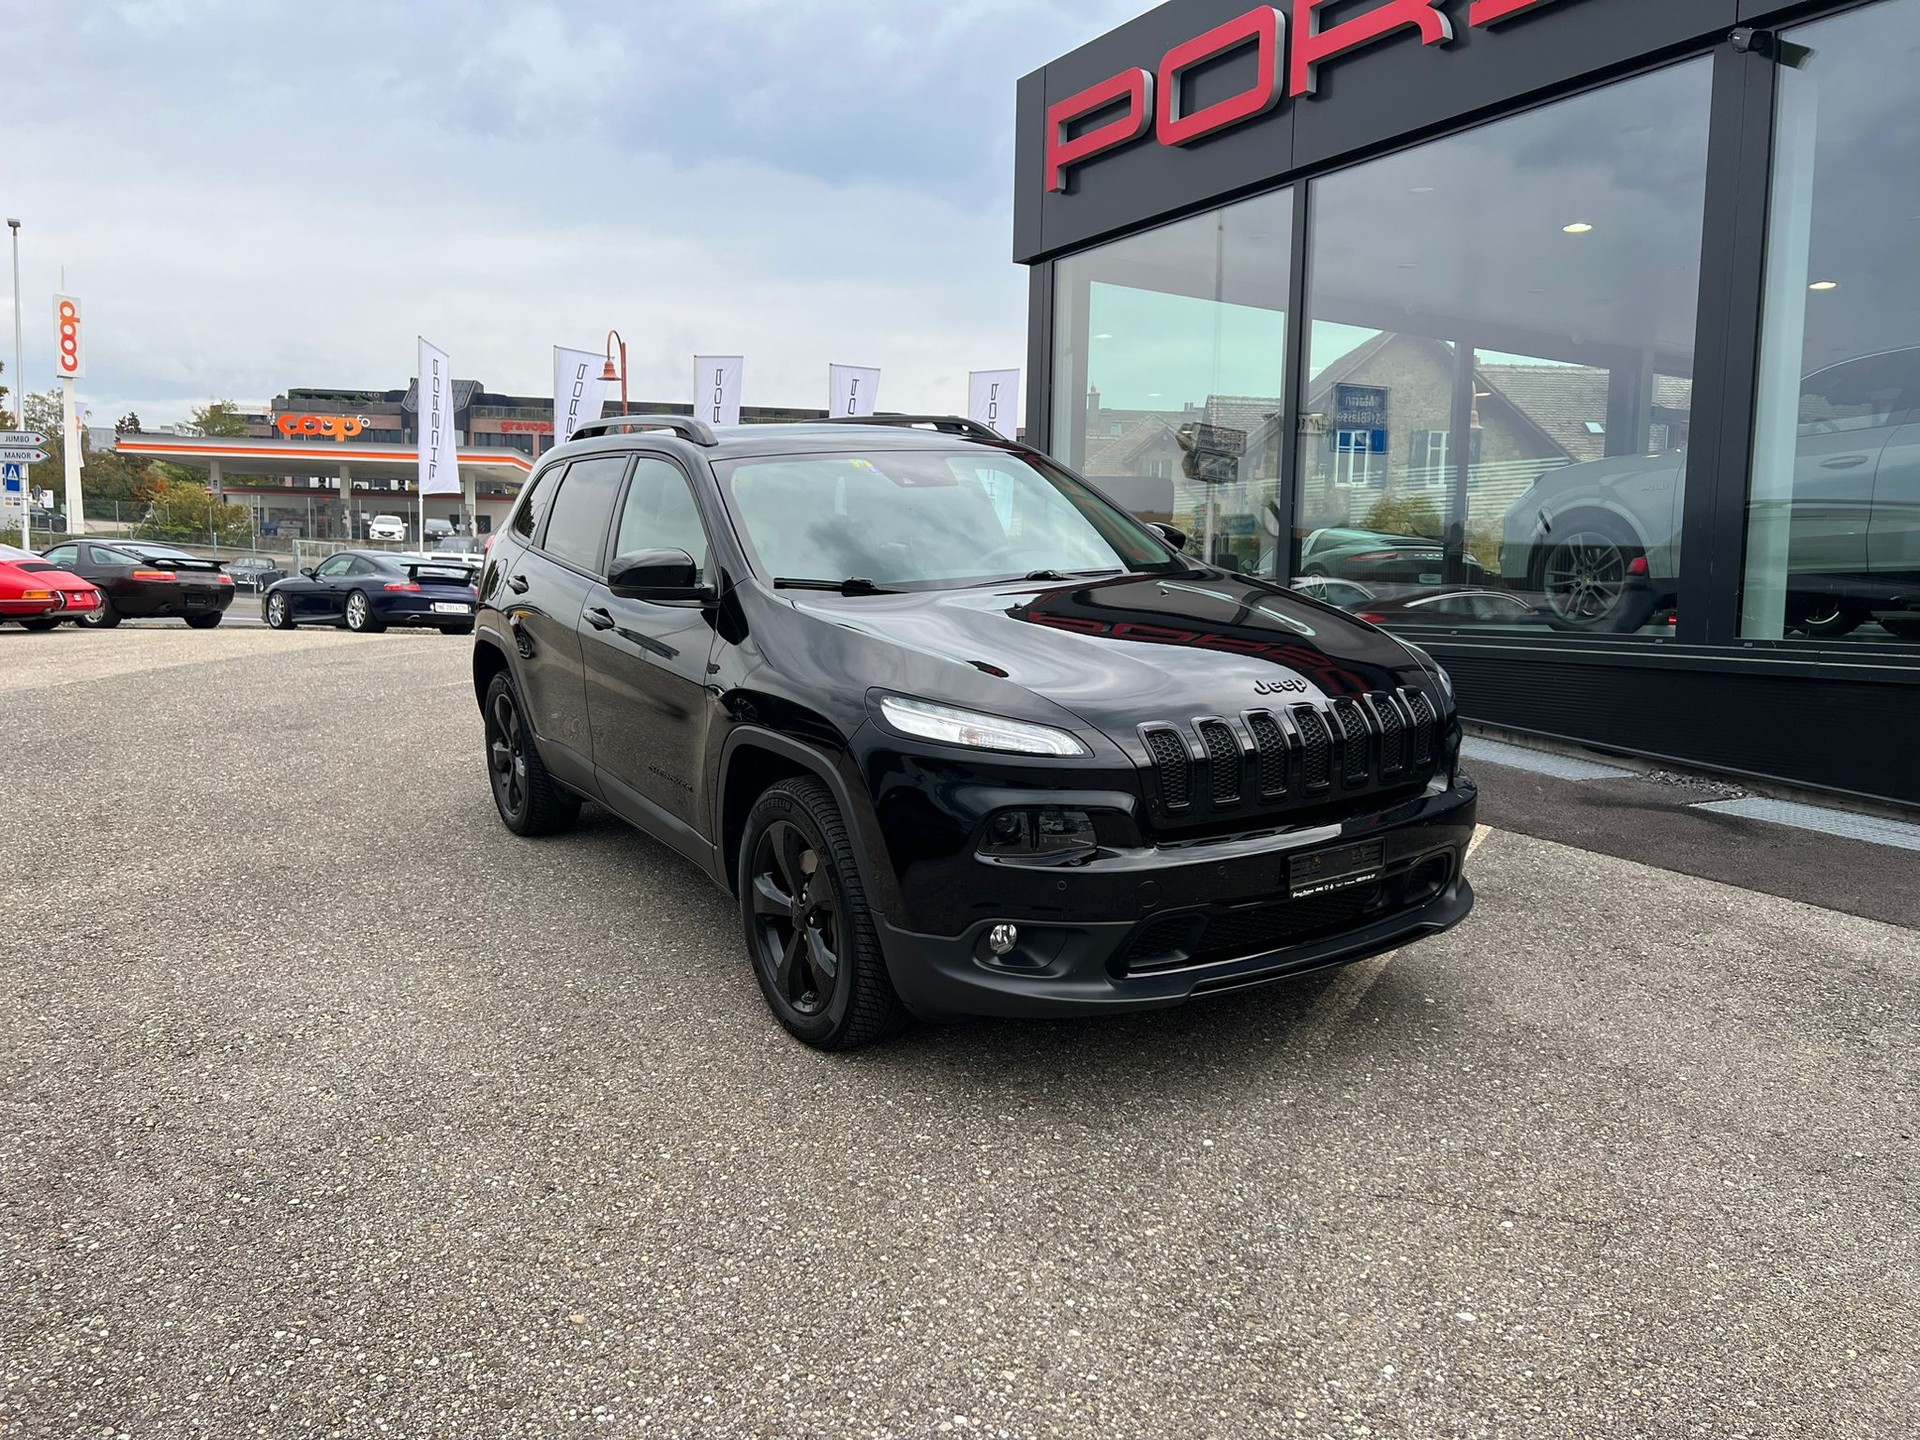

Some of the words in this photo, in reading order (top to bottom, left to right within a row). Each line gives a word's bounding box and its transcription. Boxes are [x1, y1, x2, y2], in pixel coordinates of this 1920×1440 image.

[1046, 0, 1556, 193] POR
[60, 301, 80, 371] coop
[277, 414, 362, 442] coop
[1254, 679, 1307, 695] Jeep
